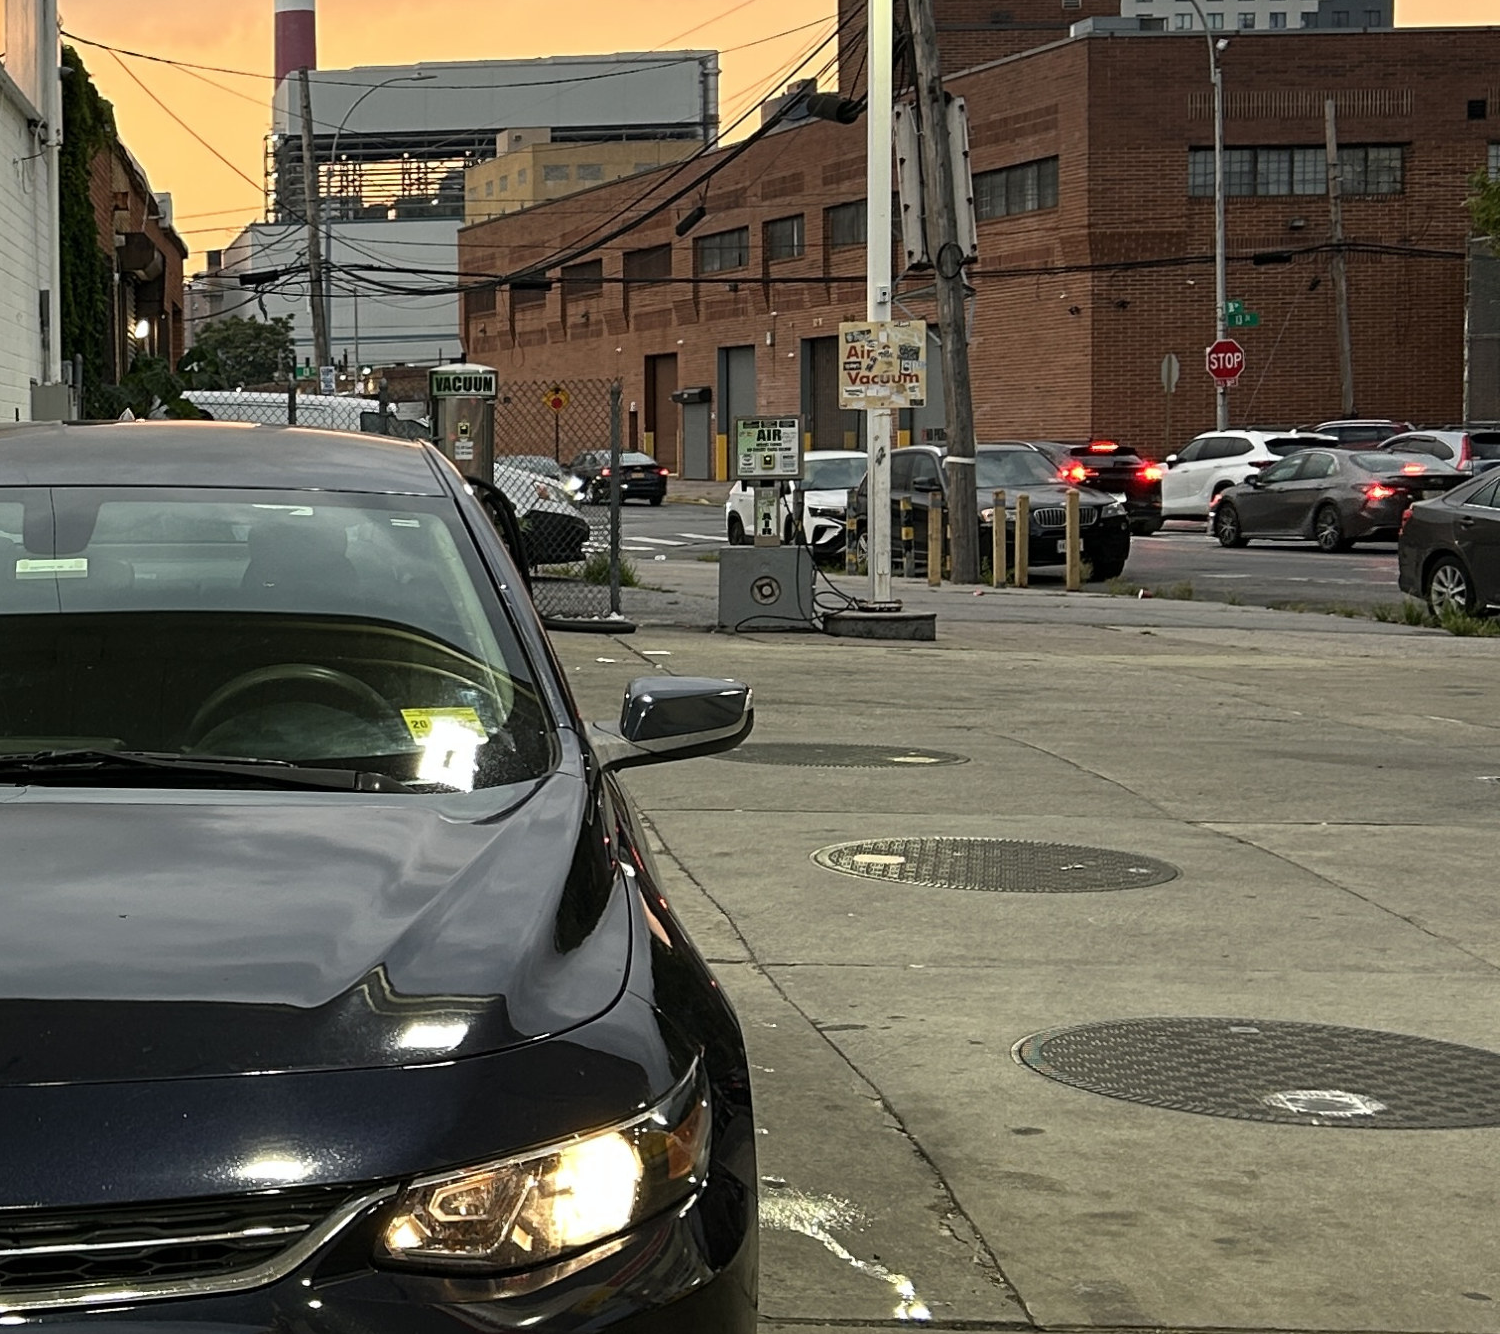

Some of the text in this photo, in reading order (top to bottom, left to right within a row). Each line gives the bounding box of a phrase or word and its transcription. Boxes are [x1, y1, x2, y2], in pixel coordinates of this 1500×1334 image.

[846, 345, 875, 359] Air
[1210, 353, 1242, 369] STOP
[435, 376, 492, 392] VACUUM
[847, 372, 919, 385] Vacuum
[757, 429, 782, 441] AIR
